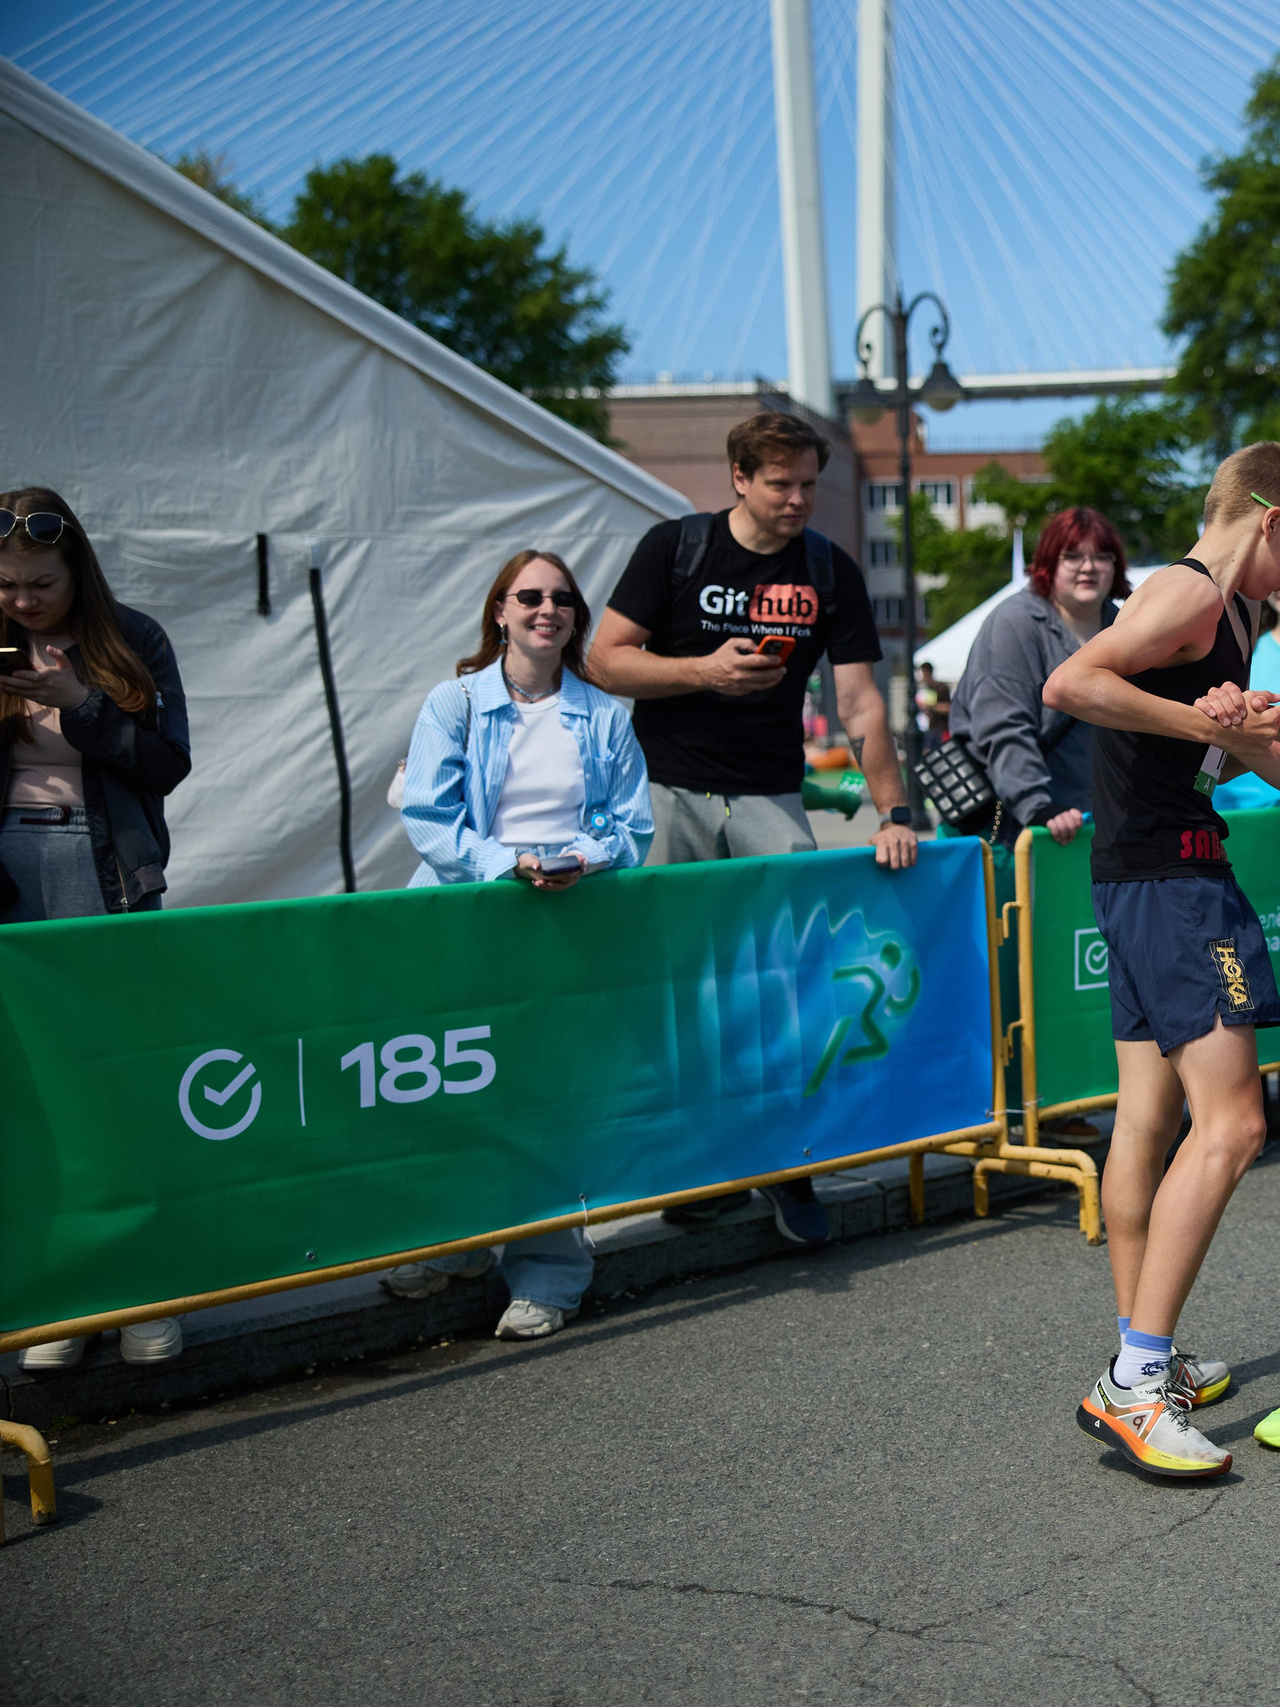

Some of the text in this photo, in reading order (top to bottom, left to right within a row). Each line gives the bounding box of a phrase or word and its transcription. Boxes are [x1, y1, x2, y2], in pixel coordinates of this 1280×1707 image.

[701, 619, 721, 632] The
[722, 623, 749, 634] Place
[751, 624, 784, 635] Where
[791, 627, 812, 637] Fork
[1216, 947, 1248, 1006] HOKA
[341, 1025, 497, 1108] 185
